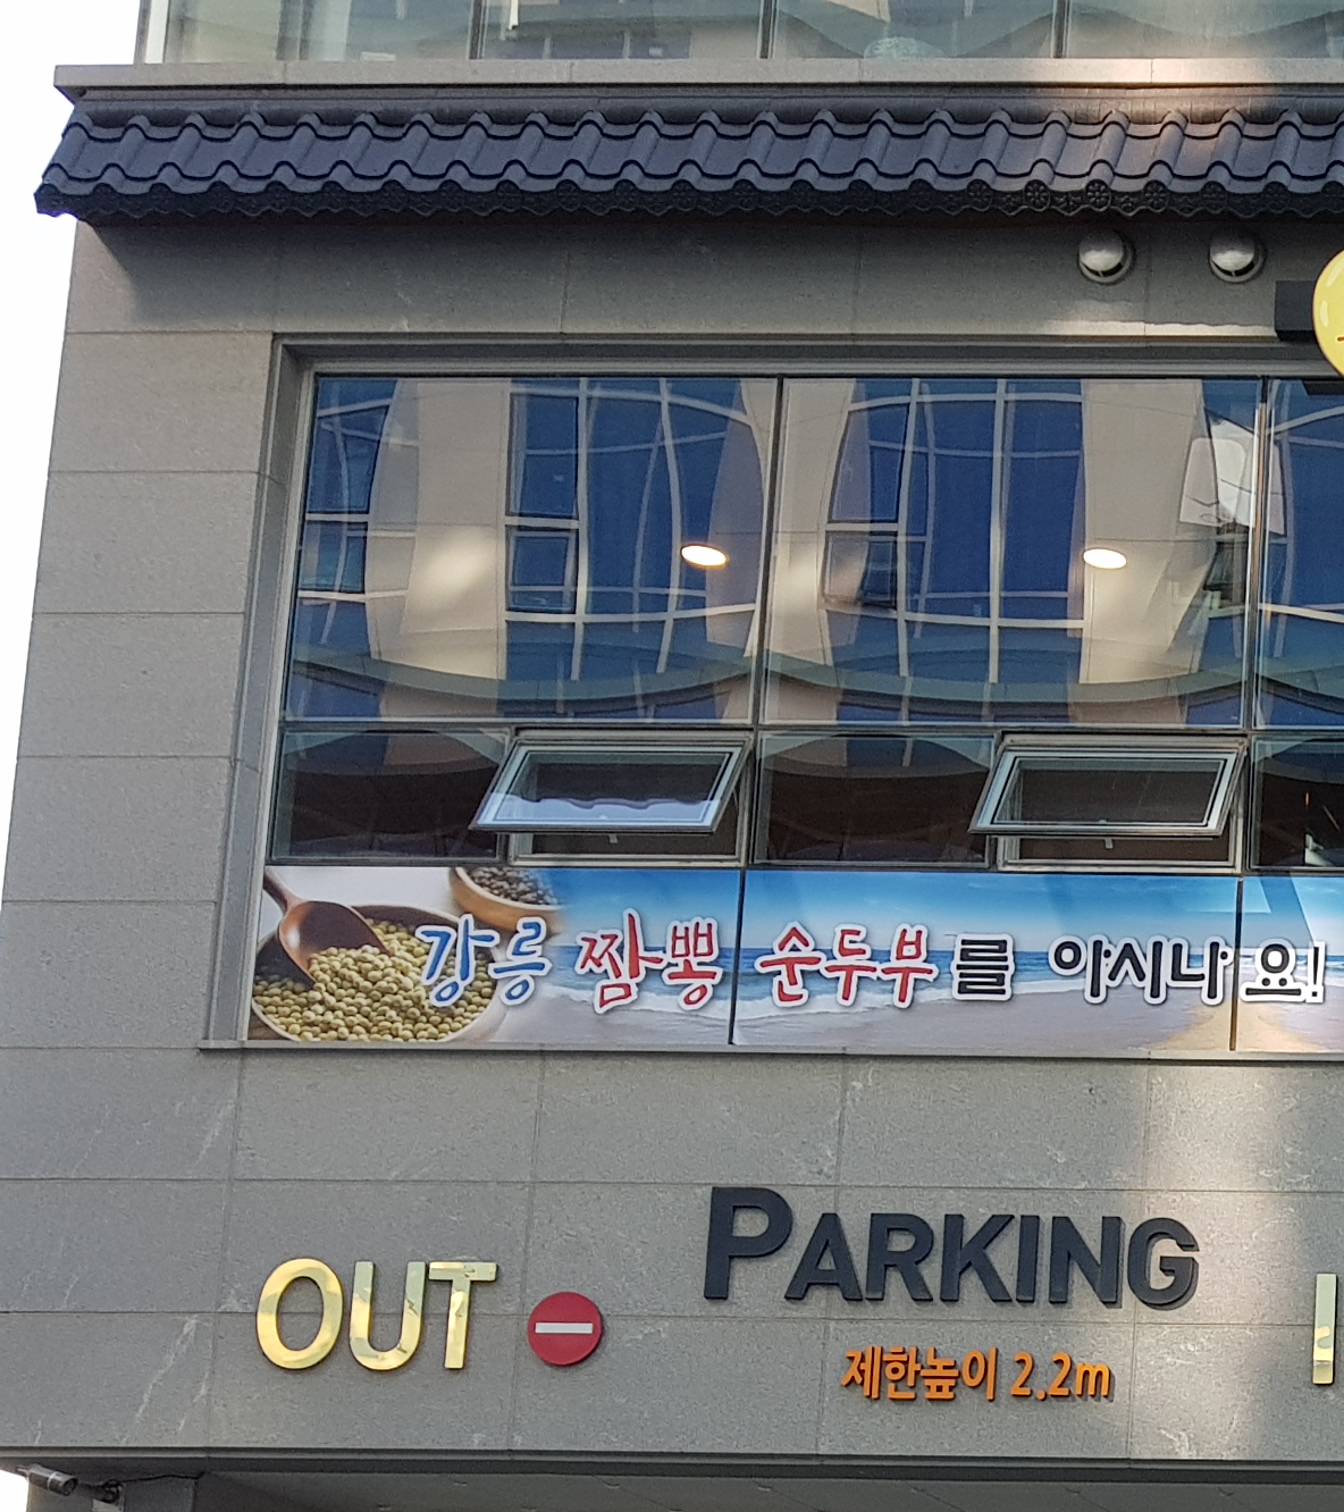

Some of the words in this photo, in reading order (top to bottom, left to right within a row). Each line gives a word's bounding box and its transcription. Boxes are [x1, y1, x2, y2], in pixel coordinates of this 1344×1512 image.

[418, 914, 550, 1005] 강릉
[578, 909, 721, 1010] 짬뽕
[257, 1257, 499, 1370] OUT
[841, 1345, 997, 1401] 제한높이
[1009, 1351, 1112, 1401] 2.2m
